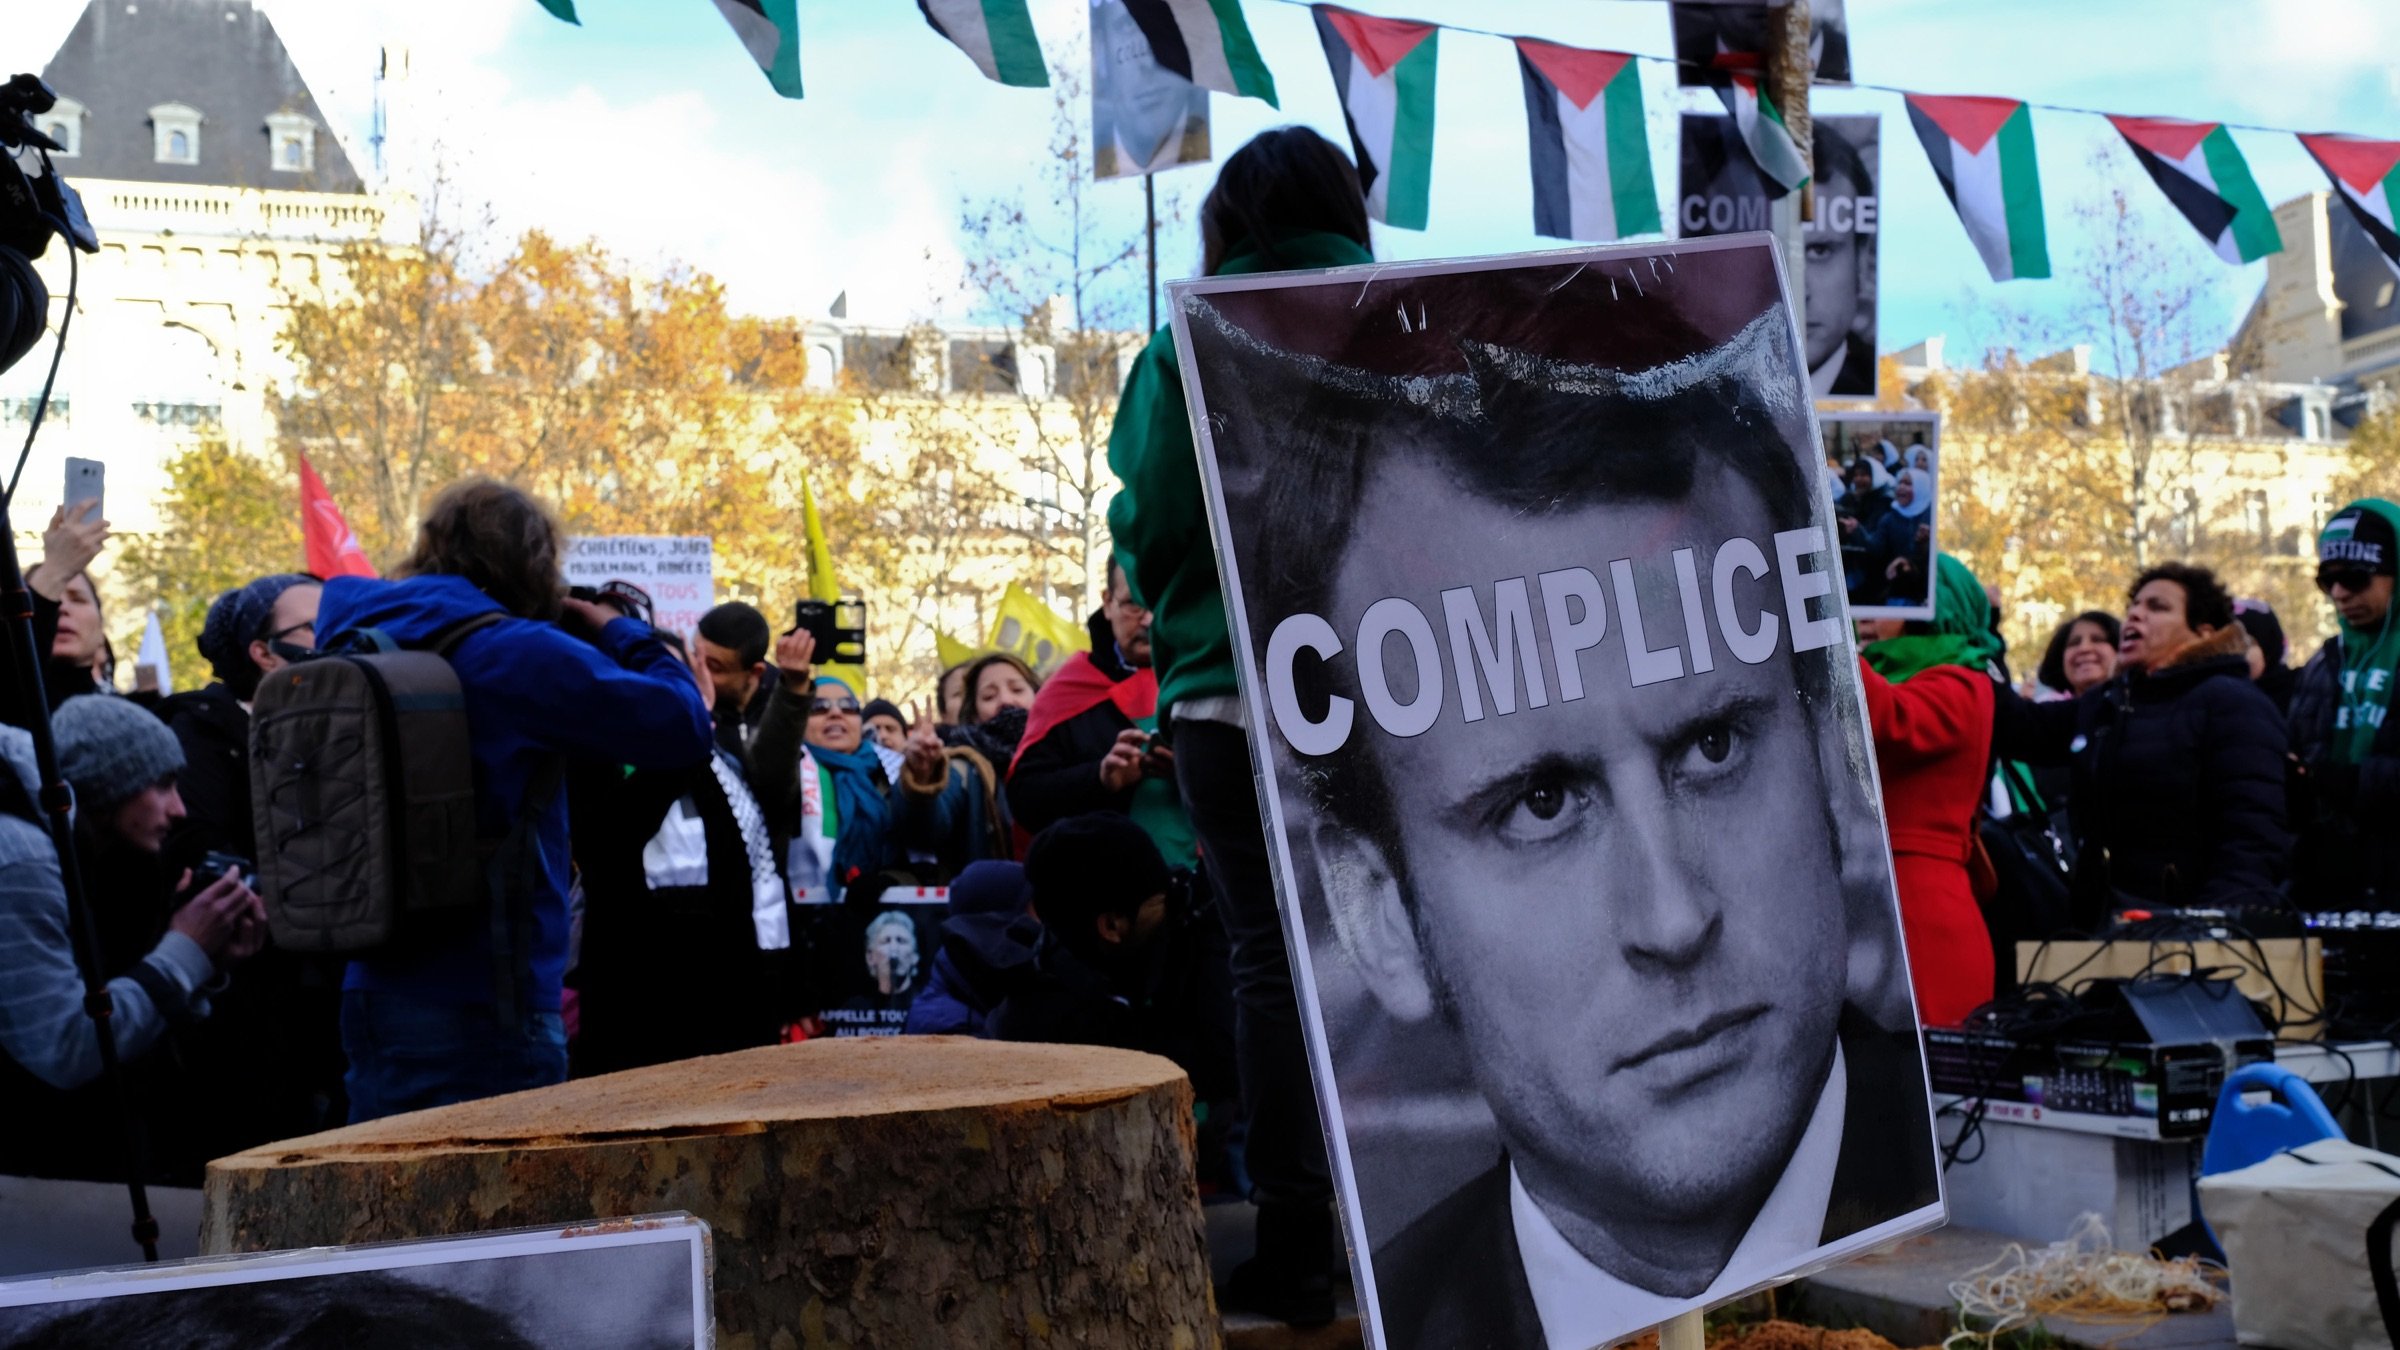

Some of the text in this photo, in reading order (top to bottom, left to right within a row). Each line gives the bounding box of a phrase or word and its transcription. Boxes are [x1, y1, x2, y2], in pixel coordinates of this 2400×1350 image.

[6, 182, 27, 207] JVC
[1682, 194, 1877, 233] COMICE
[2320, 540, 2383, 564] ESTINE
[655, 582, 700, 601] TOUS
[1264, 525, 1843, 757] COMPLICE
[818, 1009, 908, 1023] APPELLE TOU
